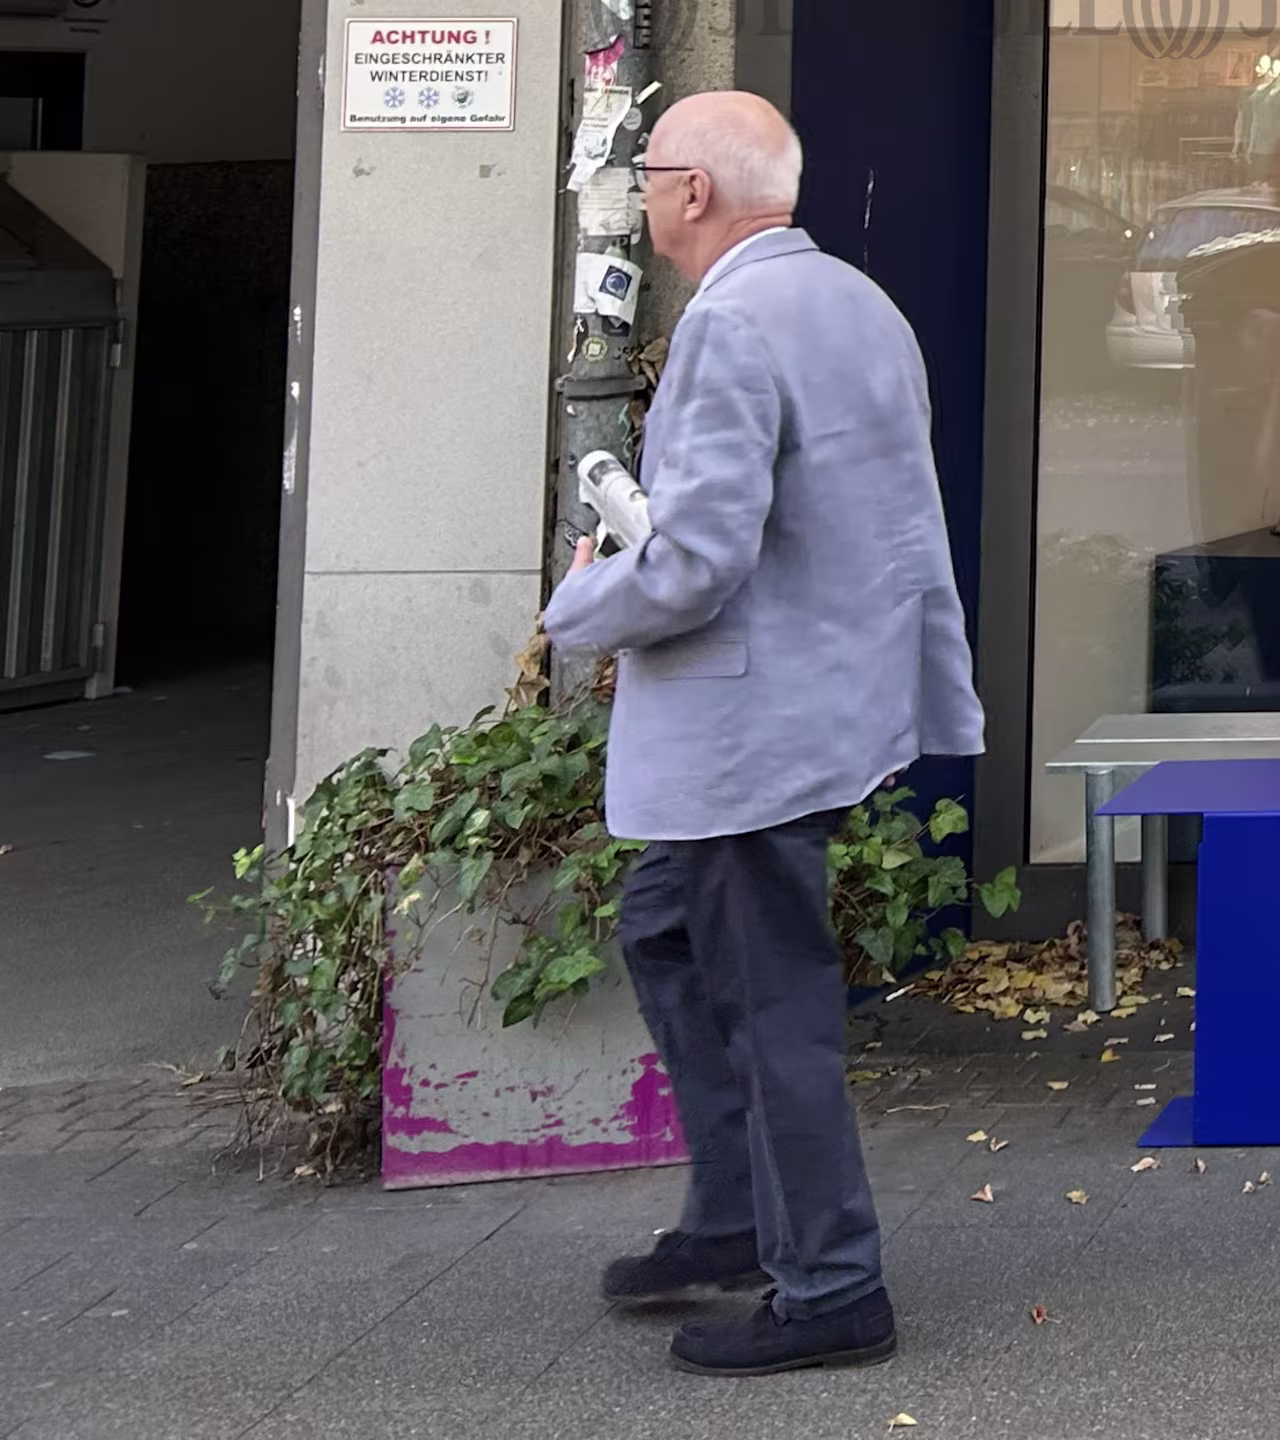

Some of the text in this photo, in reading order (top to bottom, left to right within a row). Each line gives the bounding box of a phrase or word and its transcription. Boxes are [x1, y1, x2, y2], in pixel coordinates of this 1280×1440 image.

[370, 30, 491, 44] ACHTUNG !
[354, 50, 506, 65] EINGESCHRÄNKTER
[370, 70, 488, 82] WINTERDIENST!
[349, 115, 406, 124] Benutzung
[431, 115, 466, 124] eigene
